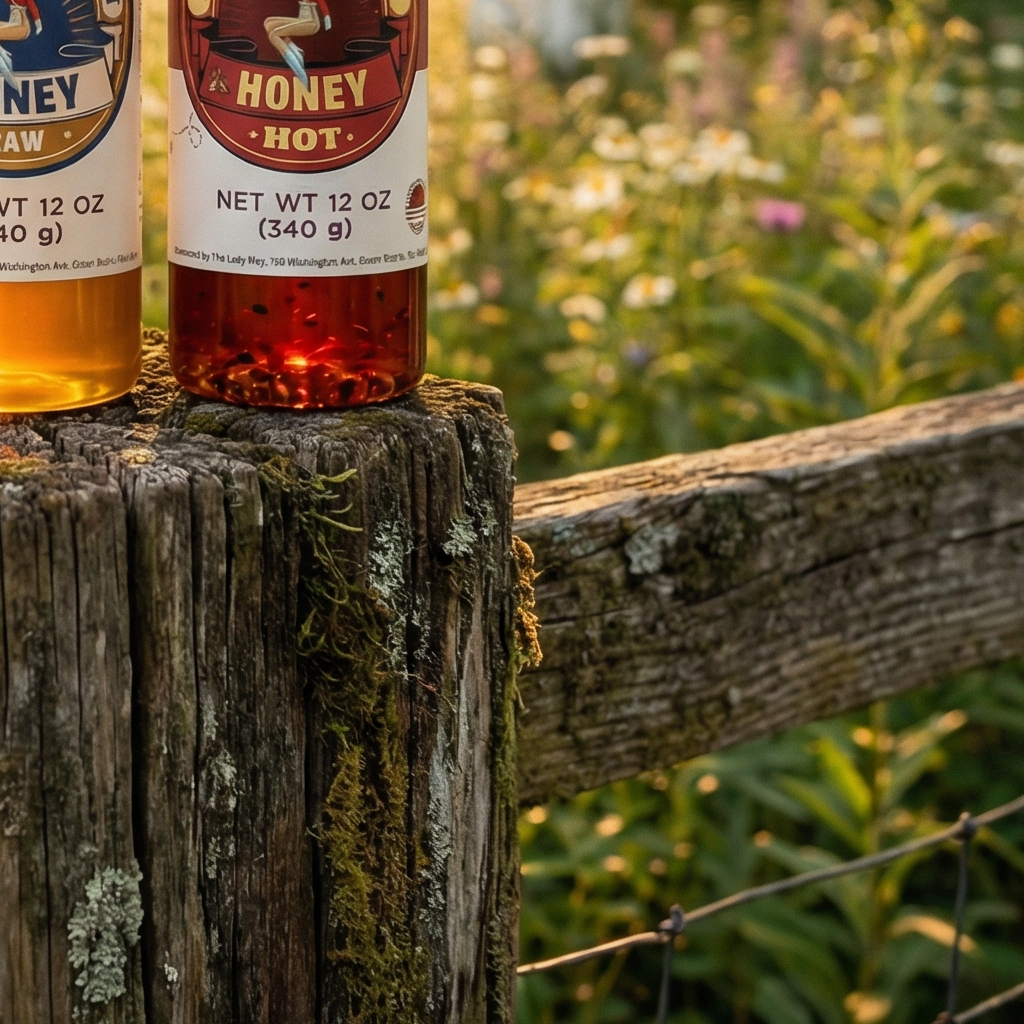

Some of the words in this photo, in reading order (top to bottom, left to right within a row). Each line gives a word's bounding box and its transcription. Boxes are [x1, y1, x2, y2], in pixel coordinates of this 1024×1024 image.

[236, 69, 367, 111] HONEY
[263, 126, 341, 151] HOT
[39, 198, 63, 216] 12
[73, 194, 105, 214] OZ
[217, 190, 264, 211] NET
[275, 193, 318, 213] WT
[328, 193, 352, 212] 12
[361, 190, 391, 210] OZ
[38, 222, 63, 246] g)
[258, 218, 317, 240] (340
[327, 218, 352, 241] g)
